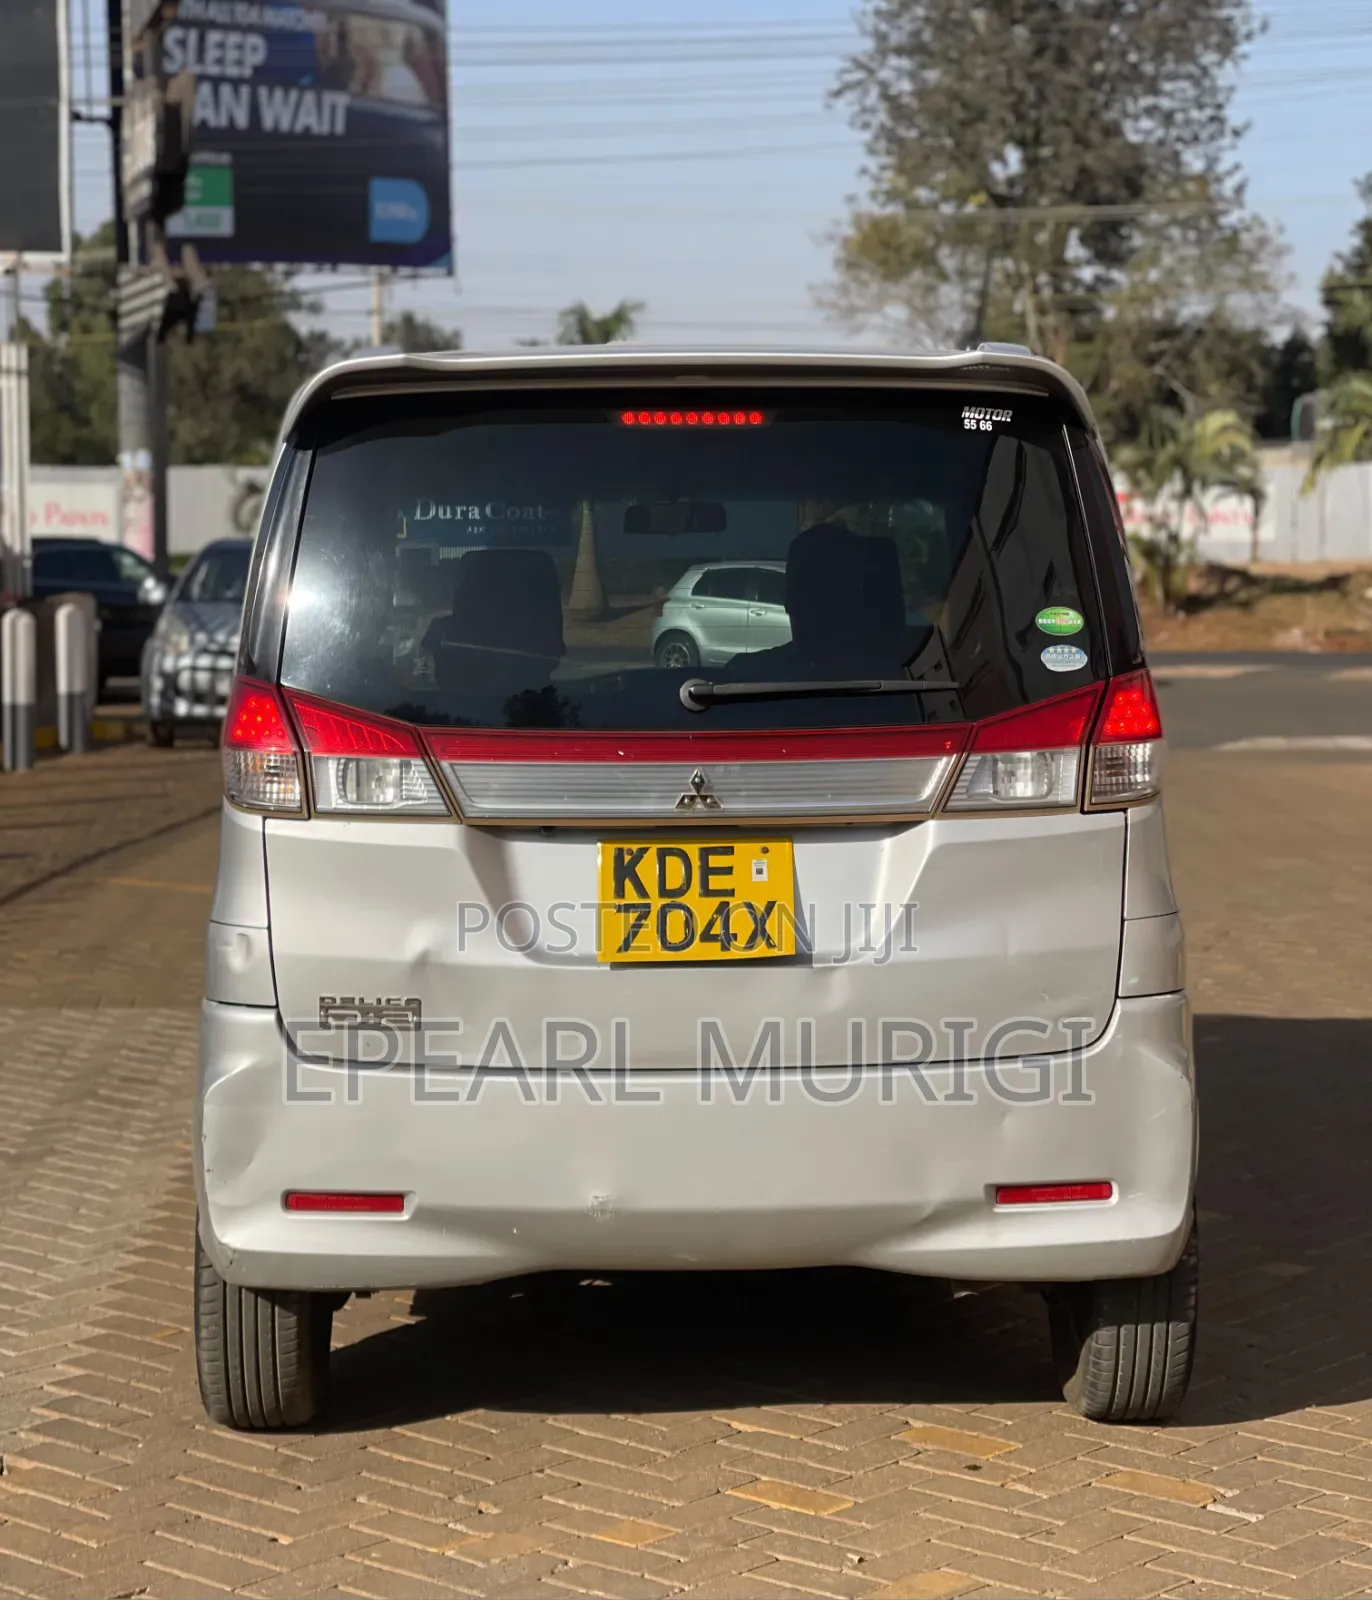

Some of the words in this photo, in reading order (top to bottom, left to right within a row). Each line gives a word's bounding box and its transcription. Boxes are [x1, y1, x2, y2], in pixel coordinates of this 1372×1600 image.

[162, 25, 267, 78] SLEEP
[194, 80, 251, 130] AN
[257, 84, 351, 135] WAIT
[961, 405, 1013, 422] MOTOR
[963, 418, 977, 430] 55
[979, 420, 993, 432] 66
[613, 846, 736, 899] KDE
[614, 900, 777, 954] 704X
